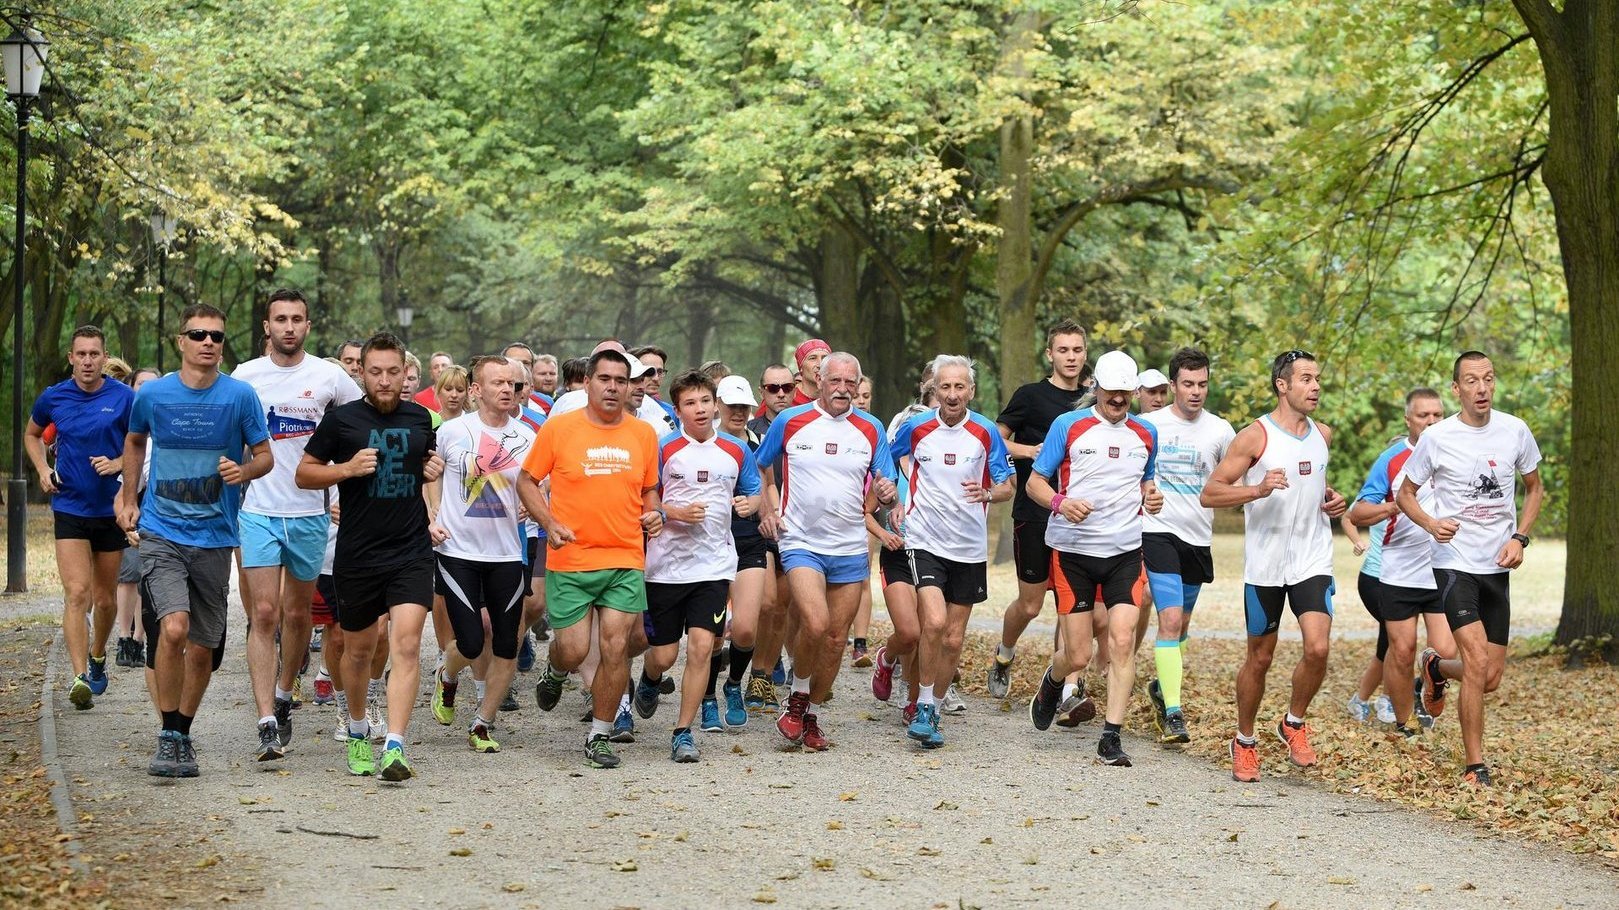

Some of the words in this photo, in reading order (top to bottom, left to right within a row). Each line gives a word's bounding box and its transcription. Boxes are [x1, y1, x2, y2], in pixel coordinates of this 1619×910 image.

[171, 418, 191, 427] Cape
[192, 418, 215, 426] Town
[368, 428, 411, 455] ACT
